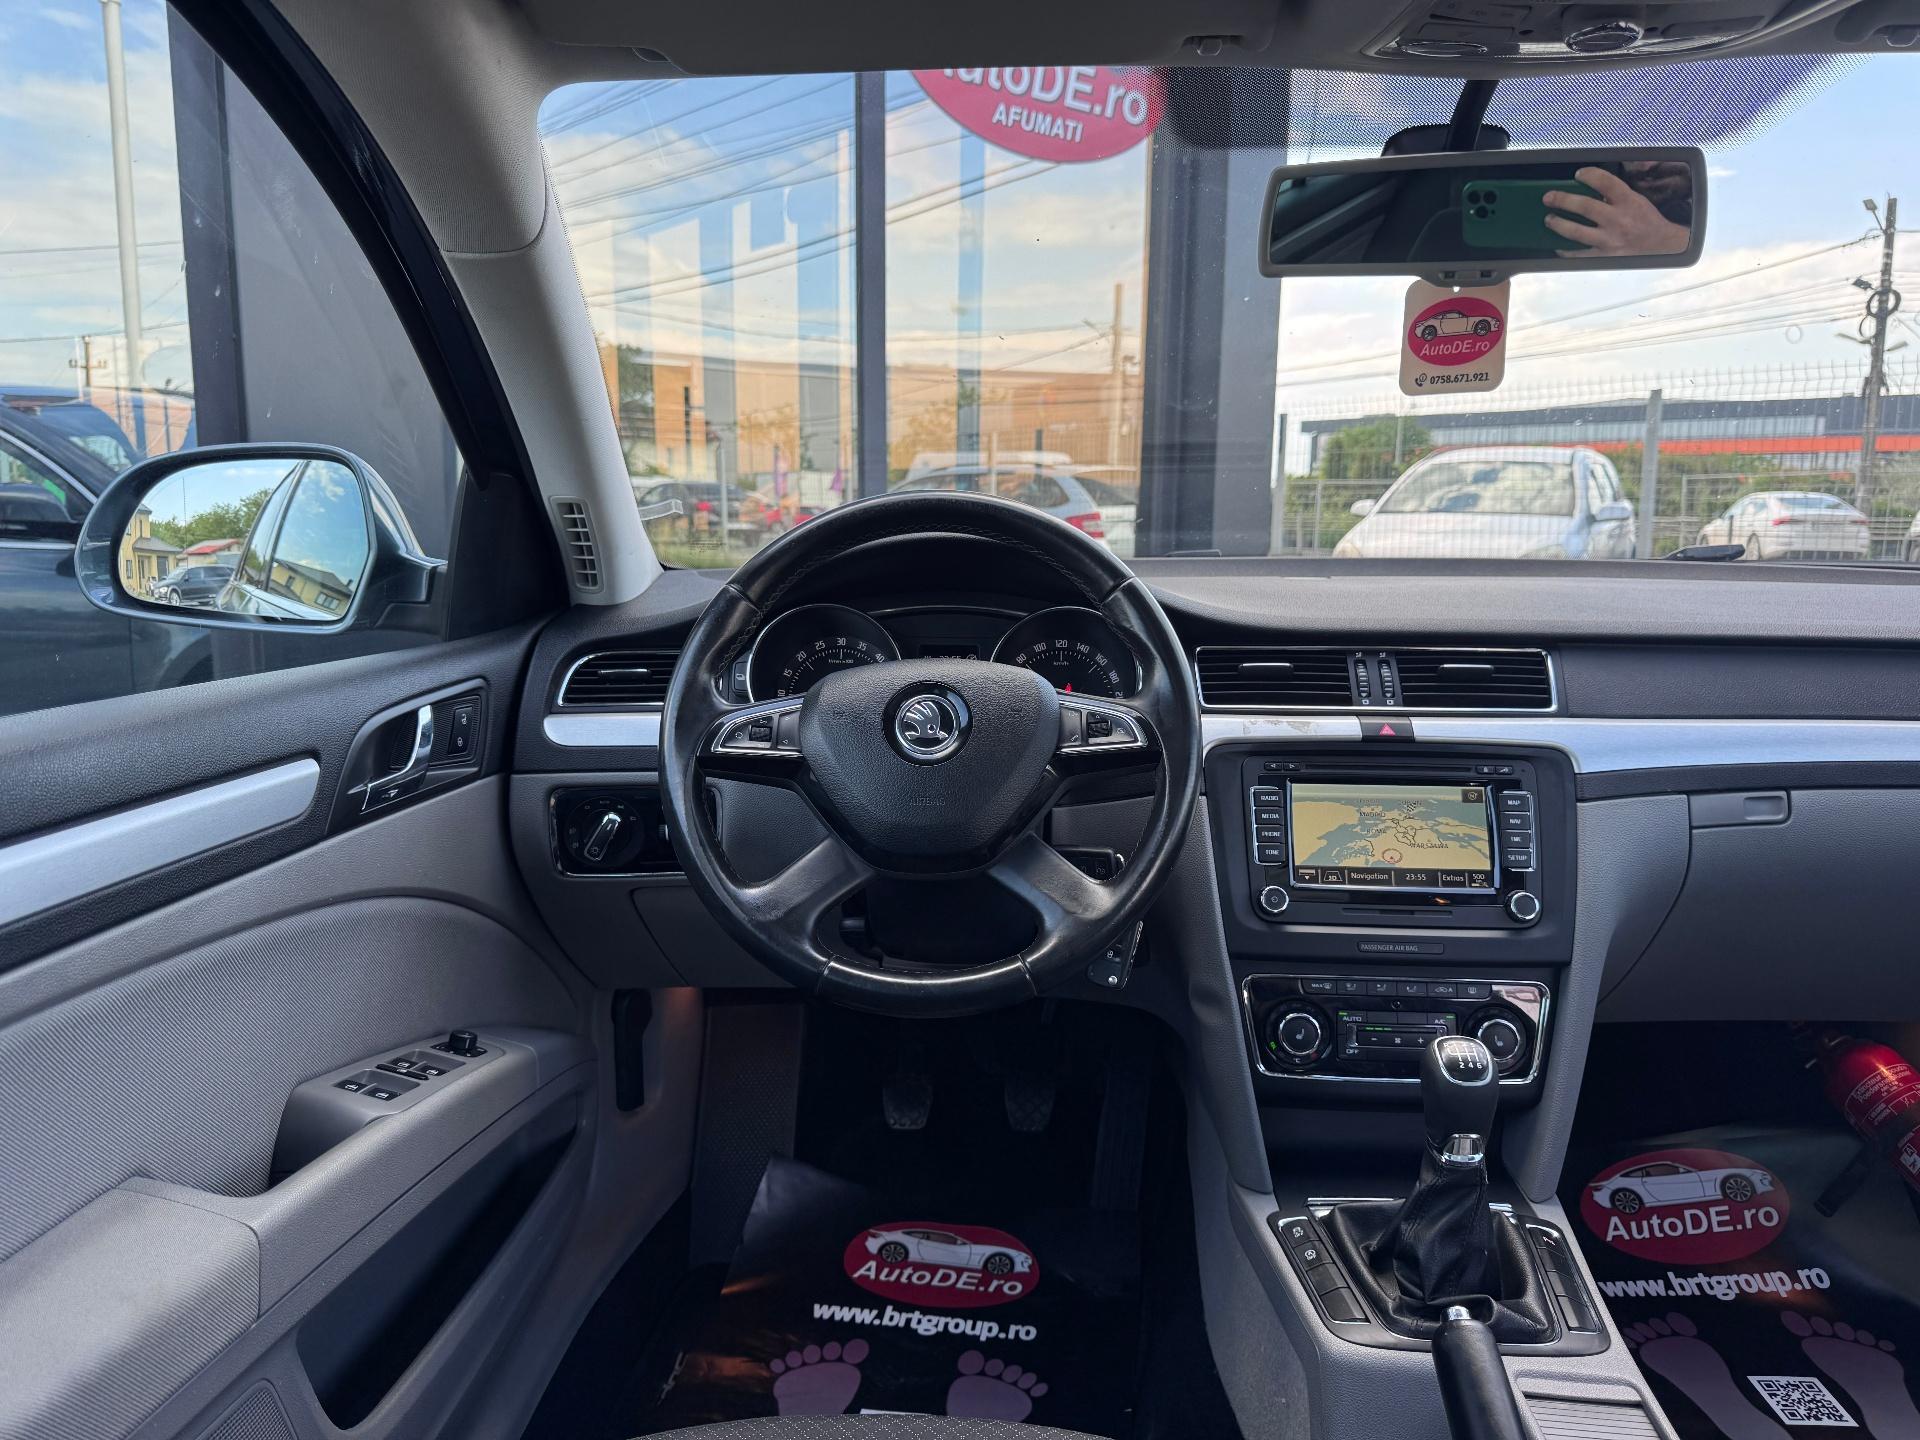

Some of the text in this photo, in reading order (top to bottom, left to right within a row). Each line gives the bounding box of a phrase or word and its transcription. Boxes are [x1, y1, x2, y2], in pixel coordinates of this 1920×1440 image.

[943, 66, 1149, 126] utoDE.ro
[991, 102, 1084, 144] AFUMATI
[1419, 339, 1491, 357] AutoDE.ro
[1429, 372, 1490, 385] 0758.671.921
[814, 640, 826, 651] 25
[836, 637, 847, 646] 30
[856, 641, 868, 651] 35
[1033, 641, 1047, 653] 100
[1055, 639, 1068, 648] 120
[1076, 642, 1090, 654] 140
[795, 651, 807, 662] 20
[874, 652, 886, 664] 40
[1015, 652, 1027, 665] 80
[1094, 653, 1108, 667] 160
[1108, 669, 1120, 684] 180
[1350, 872, 1389, 882] Navigation
[1405, 873, 1427, 881] 23:55
[1442, 874, 1464, 882] Extras
[1360, 943, 1393, 951] PASSENGER
[1468, 1061, 1474, 1069] 4
[1606, 1205, 1780, 1242] AutoDE.ro
[852, 1260, 1023, 1296] AutoDE.ro
[1598, 1267, 1831, 1301] www.brtgroup.ro
[813, 1303, 1038, 1341] www.brtgroup.ro
